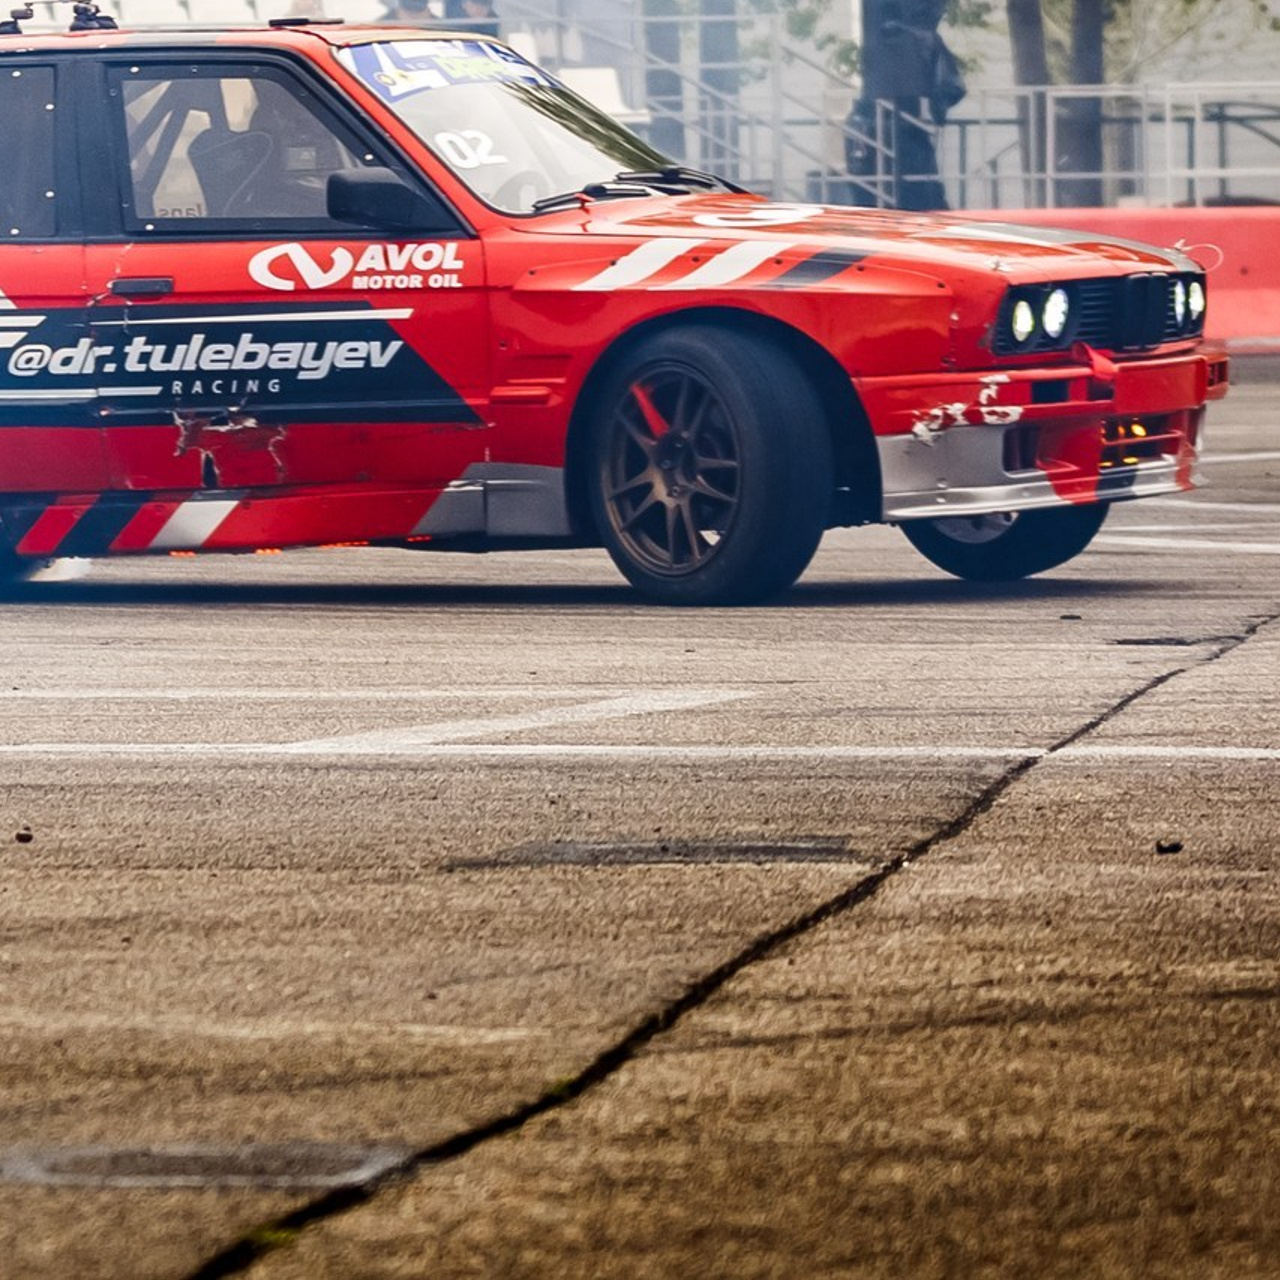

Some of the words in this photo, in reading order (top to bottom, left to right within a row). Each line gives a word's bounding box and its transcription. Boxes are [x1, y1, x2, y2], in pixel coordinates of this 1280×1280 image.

[434, 129, 509, 169] 02
[354, 242, 464, 271] AVOL
[352, 275, 423, 290] MOTOR
[428, 273, 463, 288] OIL
[7, 333, 404, 380] @dr.tulebayev
[172, 379, 281, 395] RACING
